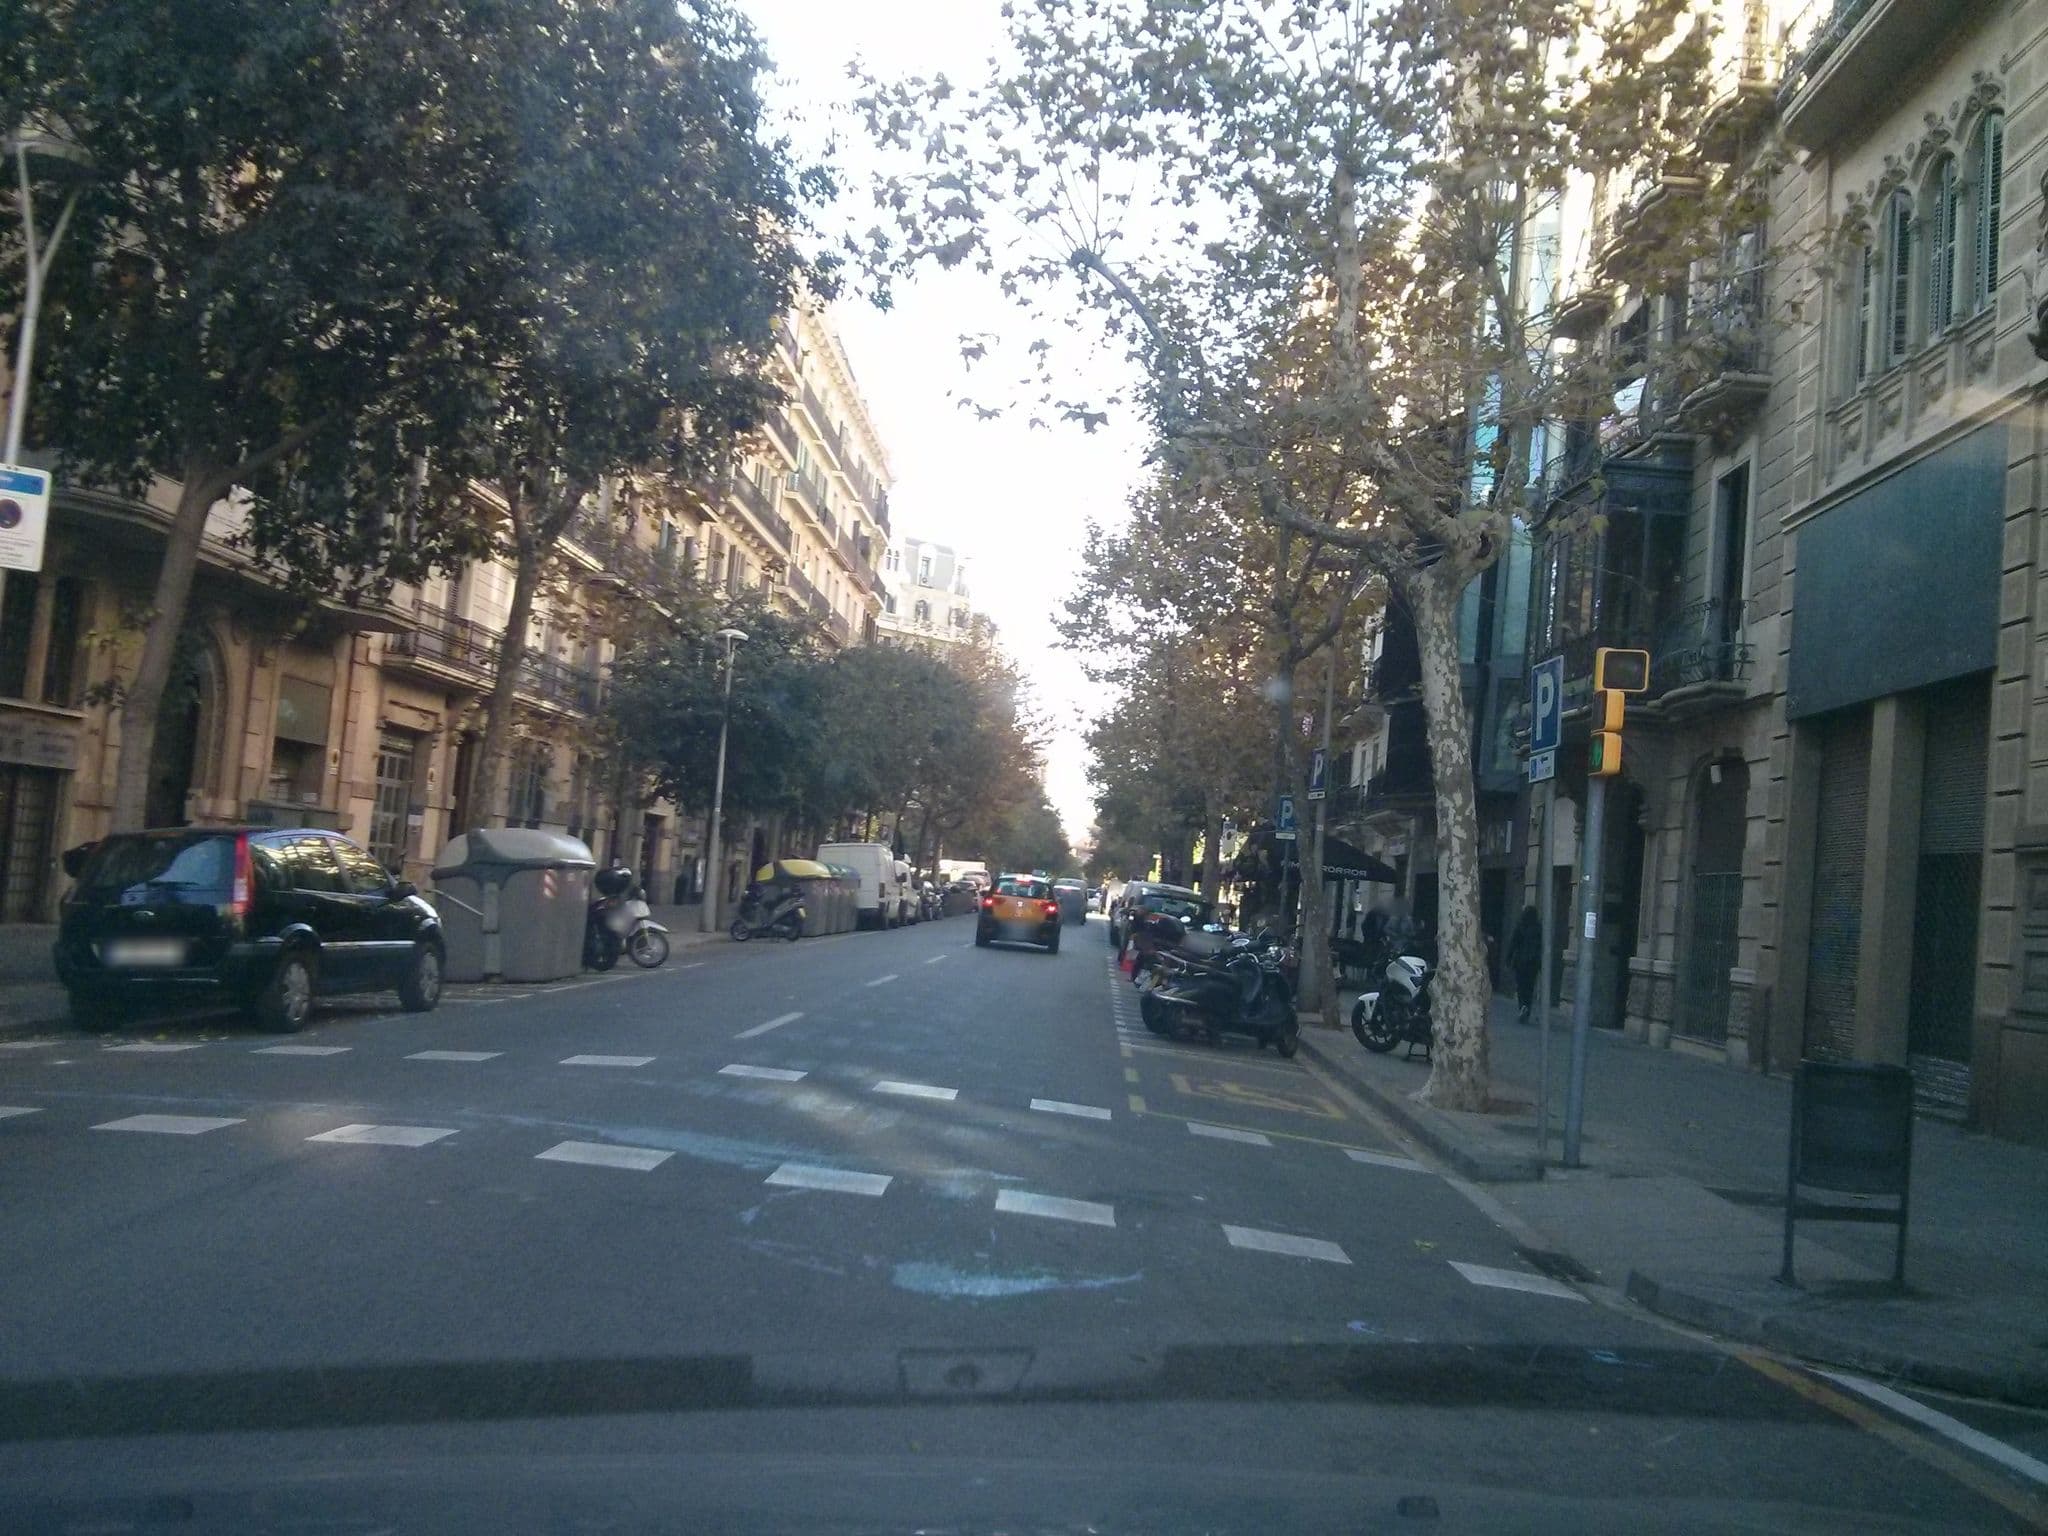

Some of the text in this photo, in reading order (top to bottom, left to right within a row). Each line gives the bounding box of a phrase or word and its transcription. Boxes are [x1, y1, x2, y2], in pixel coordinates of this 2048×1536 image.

[1535, 672, 1554, 741] P
[1313, 753, 1323, 786] P
[1281, 800, 1293, 828] P
